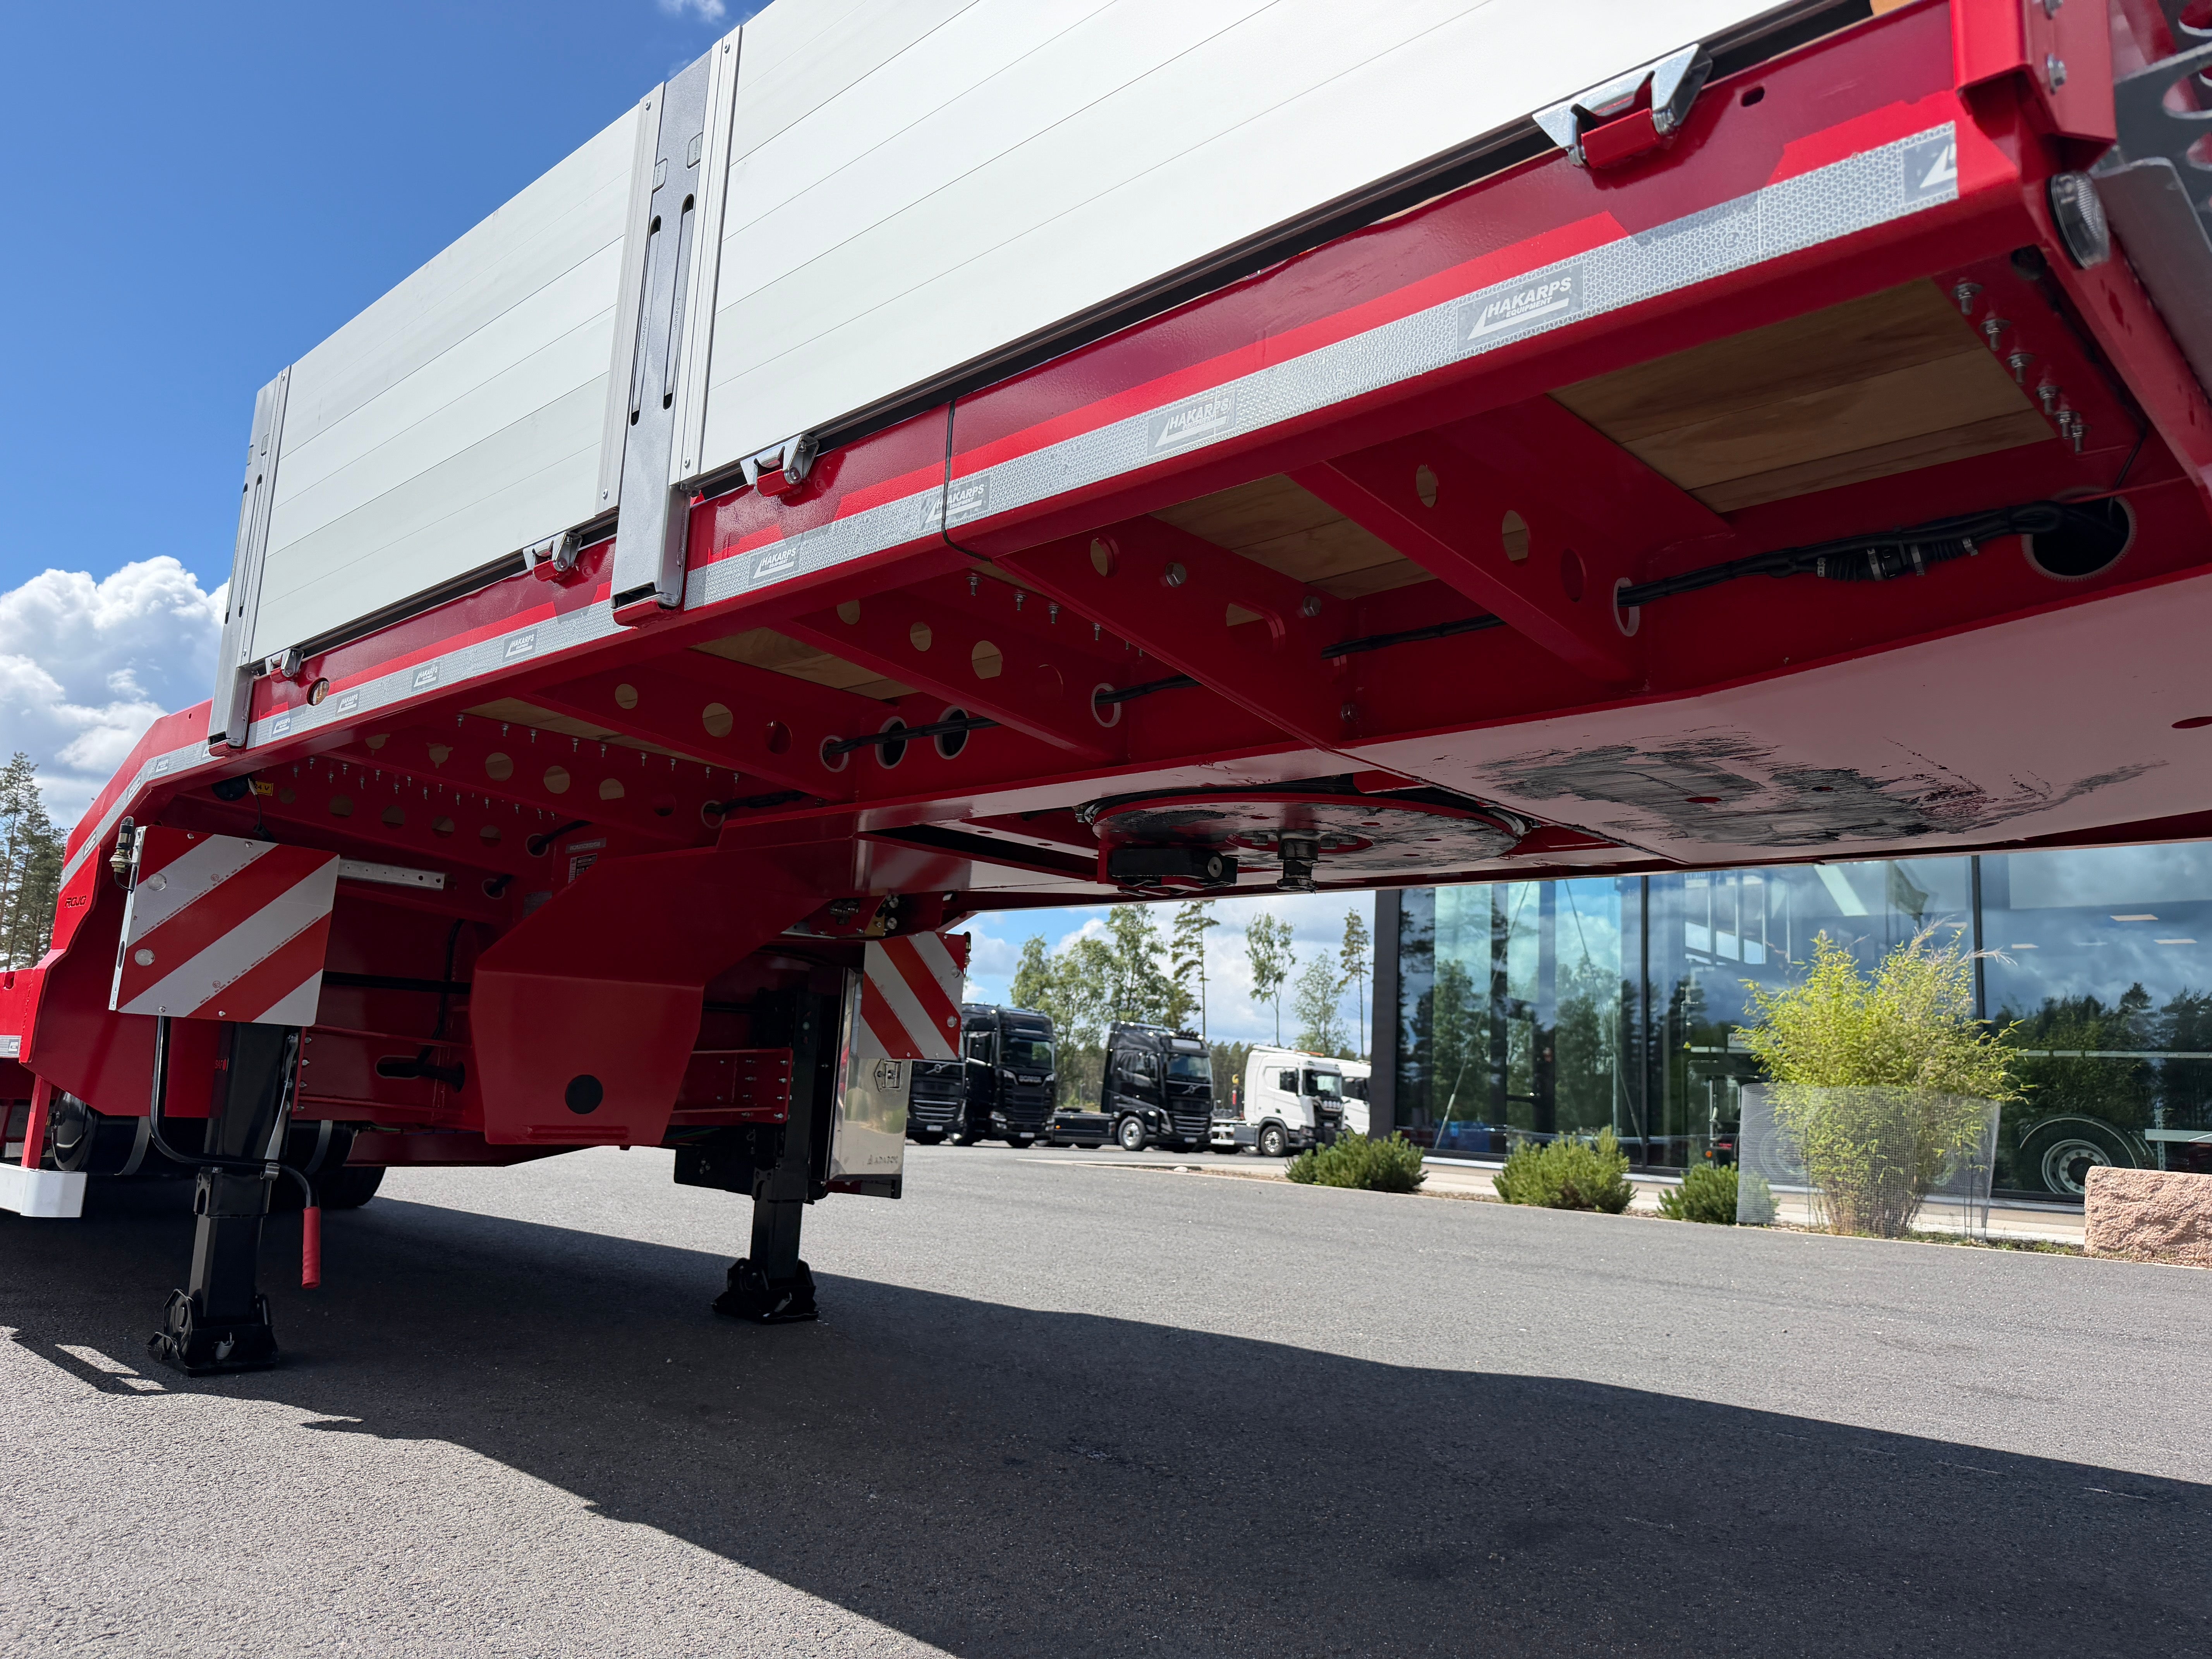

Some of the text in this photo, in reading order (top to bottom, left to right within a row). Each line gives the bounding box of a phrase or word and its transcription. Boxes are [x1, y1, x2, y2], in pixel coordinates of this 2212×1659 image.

[1487, 277, 1571, 318] HAKARPS
[1506, 297, 1553, 318] EQUIPMENT
[1169, 398, 1229, 429] HAKARPS
[936, 484, 985, 509] HAKARPS
[762, 548, 796, 566] HAKARPS
[511, 634, 534, 648] HAKARPS
[64, 895, 86, 907] ROJO
